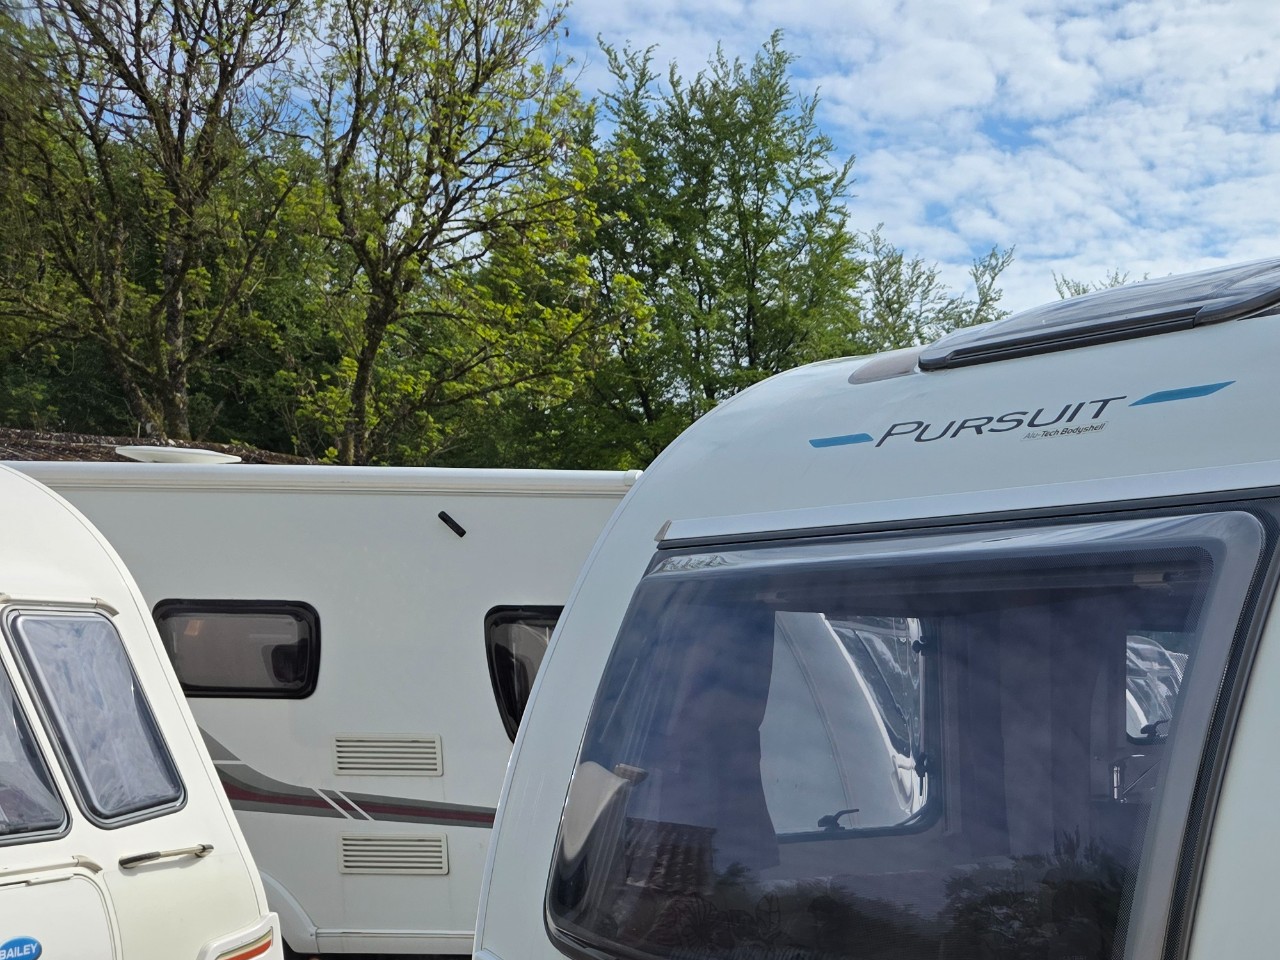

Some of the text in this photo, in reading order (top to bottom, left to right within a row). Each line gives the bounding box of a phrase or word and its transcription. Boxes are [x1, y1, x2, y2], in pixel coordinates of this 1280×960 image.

[875, 395, 1127, 447] PURSUIT
[1023, 422, 1106, 439] Alu-Tech Bodyshell
[0, 943, 38, 960] BAILEY
